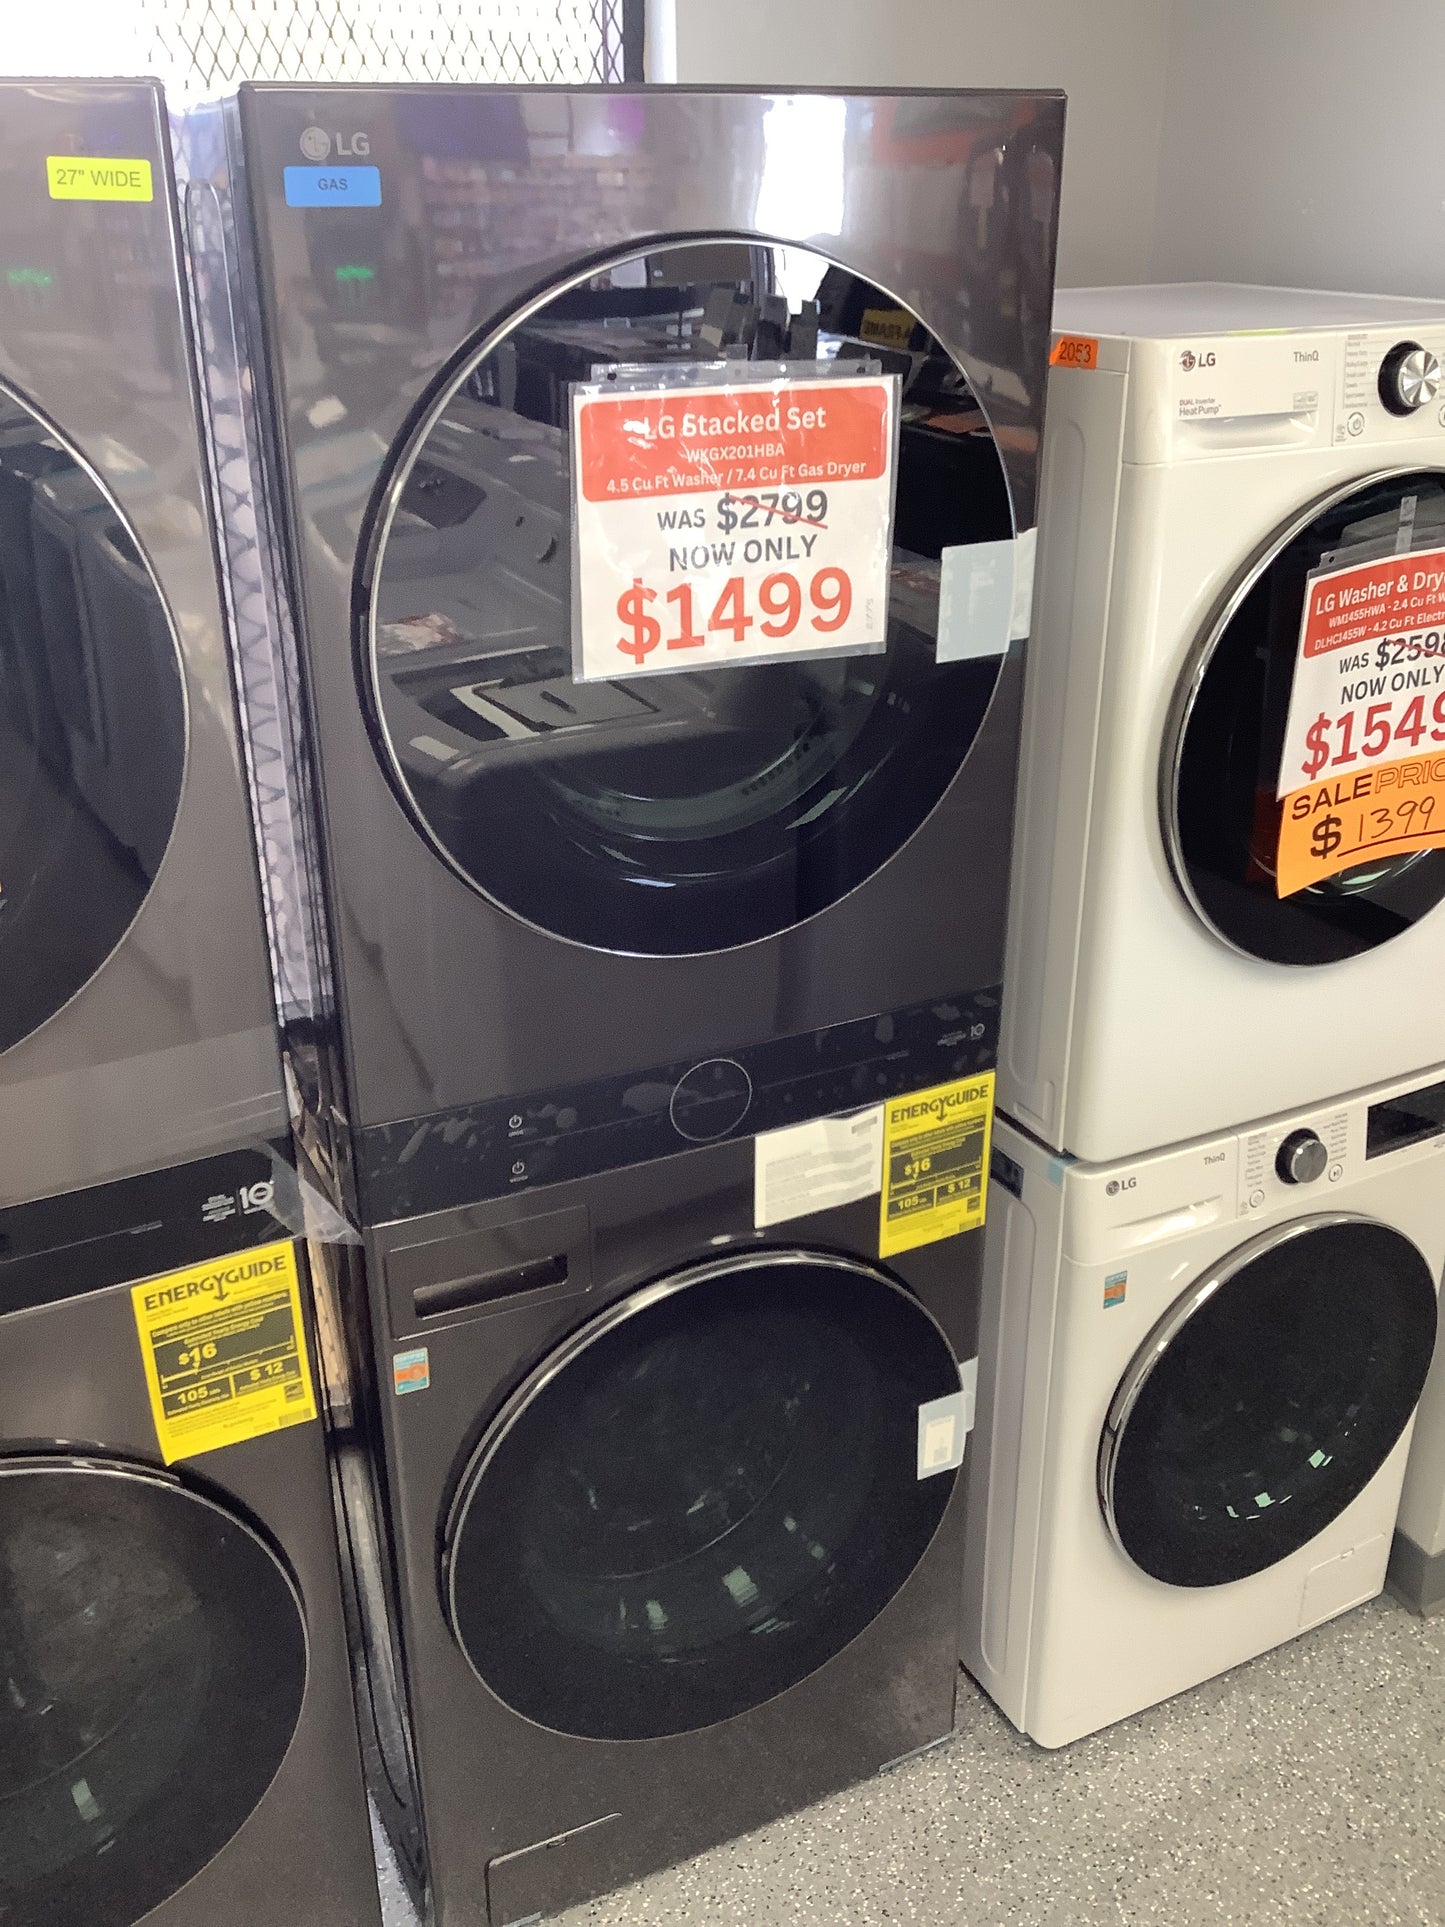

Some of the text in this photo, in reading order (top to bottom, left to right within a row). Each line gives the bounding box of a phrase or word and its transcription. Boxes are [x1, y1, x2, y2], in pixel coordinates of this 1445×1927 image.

[336, 131, 371, 156] LG
[56, 169, 142, 188] 27" WIDE
[317, 178, 349, 192] GAS
[1059, 341, 1091, 363] 2053
[1198, 350, 1319, 367] LG ThinQ
[642, 406, 827, 440] LG Stacked Set
[1179, 406, 1198, 416] Heat
[688, 443, 785, 463] WKGX201HBA
[606, 461, 867, 493] 4.5 Cu Ft Washer / 7.4 Cu Ft Gas Dryer
[657, 489, 828, 535] WAS $2799
[669, 534, 818, 572] NOW ONLY
[1316, 571, 1445, 616] LG Washer & Dry
[616, 566, 853, 665] $1499
[1329, 603, 1386, 628] WM1455HWA
[1393, 600, 1408, 612] 2.4
[1410, 597, 1424, 608] Cu
[1426, 593, 1436, 605] Ft
[1314, 625, 1367, 651] DLHC1455W
[1373, 620, 1387, 633] 4.2
[1389, 617, 1402, 629] Cu
[1404, 615, 1414, 628] Ft
[1340, 652, 1370, 674] WAS
[1341, 664, 1445, 705] NOW ONLY
[1358, 796, 1436, 843] 1399
[891, 1084, 989, 1124] ENERGYGUIDE
[904, 1157, 931, 1176] $16
[1121, 1152, 1226, 1190] LG ThinQ
[898, 1196, 919, 1210] 105
[144, 1255, 287, 1311] ENERGYGUIDE
[178, 1343, 217, 1366] $16
[177, 1386, 209, 1404] 105
